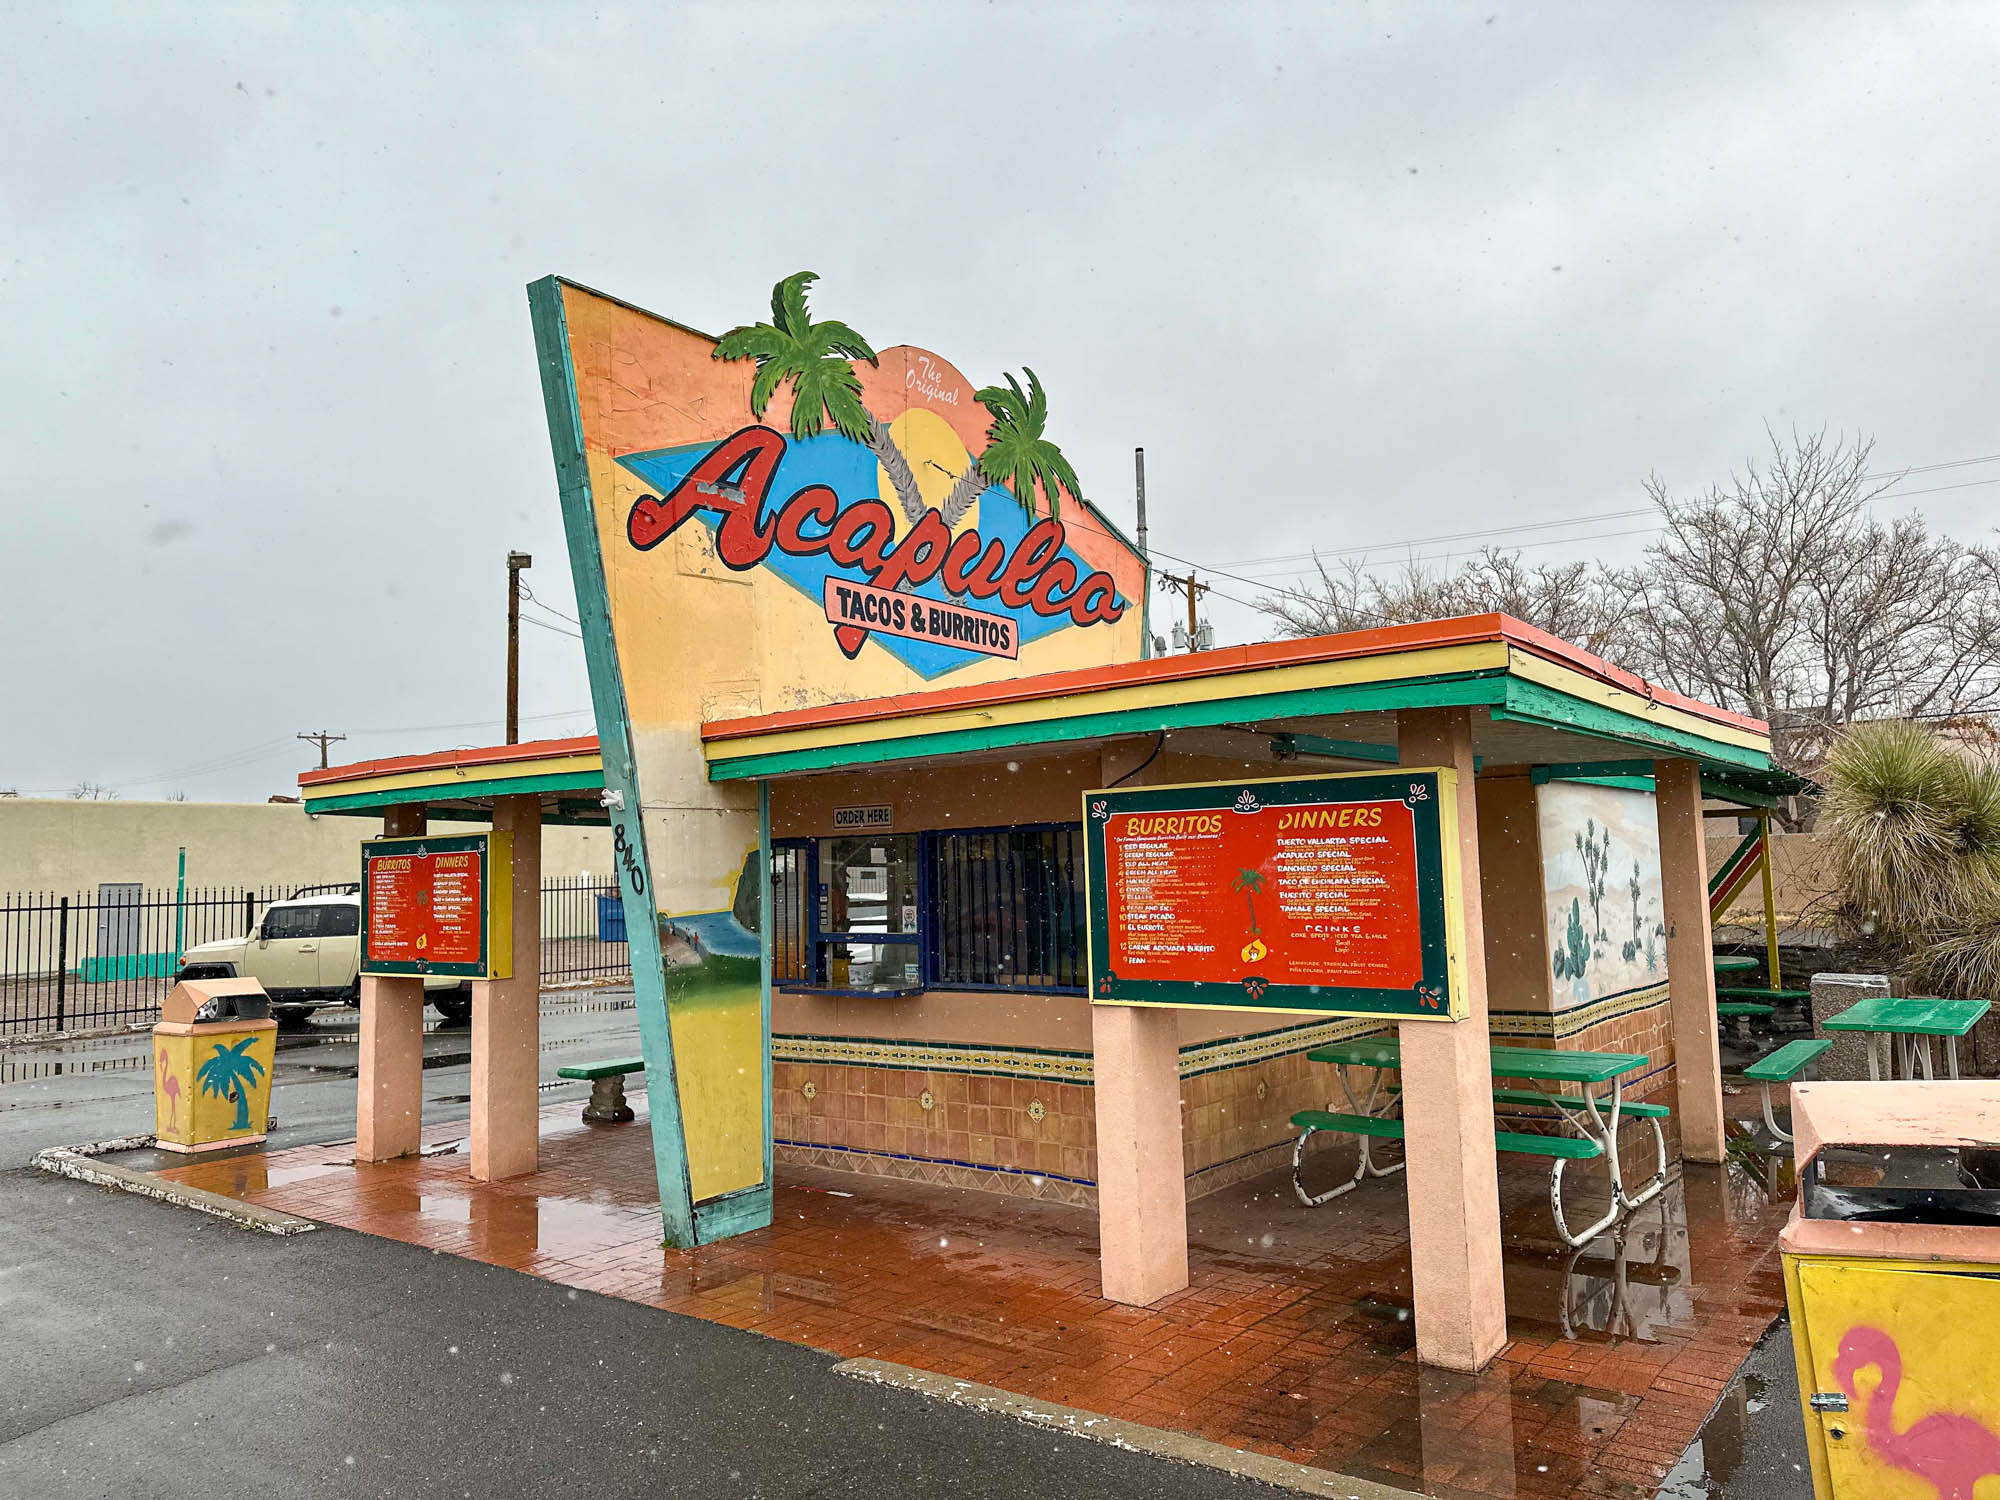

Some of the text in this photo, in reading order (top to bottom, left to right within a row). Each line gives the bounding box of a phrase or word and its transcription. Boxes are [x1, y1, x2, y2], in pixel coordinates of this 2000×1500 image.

[919, 356, 942, 384] The
[906, 368, 959, 406] Original
[627, 425, 1125, 659] Acapulco
[836, 586, 906, 631] TACOS
[911, 603, 926, 634] &
[836, 808, 890, 824] ORDER HERE
[1127, 814, 1222, 836] BURRITOS
[1278, 808, 1382, 830] DINNERS
[1277, 836, 1389, 846] PUERTO VALLARTA SPECIAL
[377, 856, 469, 871] BURRITOS DINNERS
[614, 823, 645, 896] 840
[1318, 850, 1352, 858] SPECIAL
[1321, 864, 1356, 872] SPECIAL
[1278, 878, 1298, 886] TACO
[1315, 905, 1350, 913] SPECIAL
